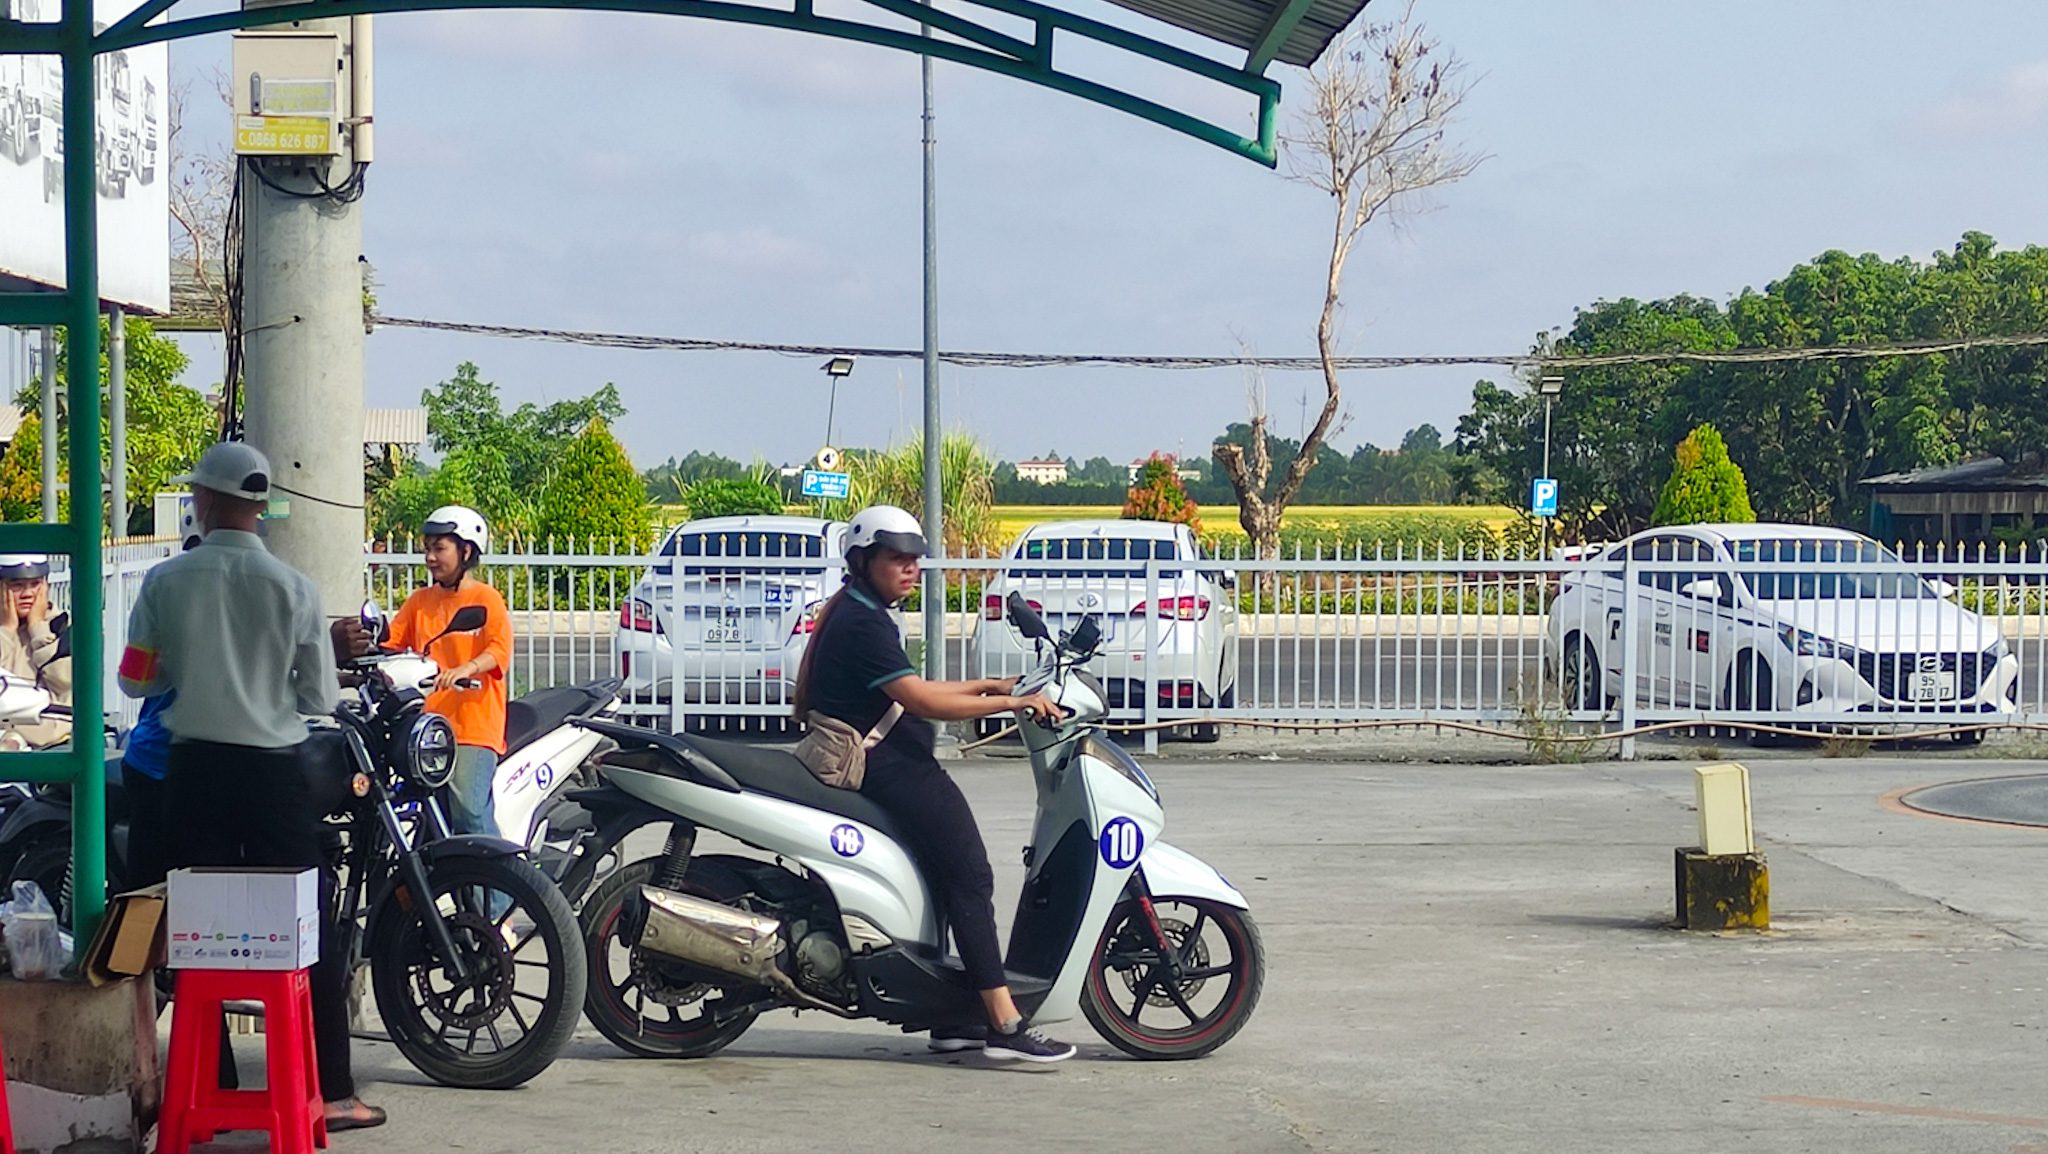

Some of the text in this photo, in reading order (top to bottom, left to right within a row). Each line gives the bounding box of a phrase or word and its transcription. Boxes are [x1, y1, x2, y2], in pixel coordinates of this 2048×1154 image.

[280, 133, 302, 148] 626
[806, 474, 818, 490] P
[1536, 483, 1555, 507] P
[537, 764, 550, 788] 9
[1107, 822, 1137, 862] 10
